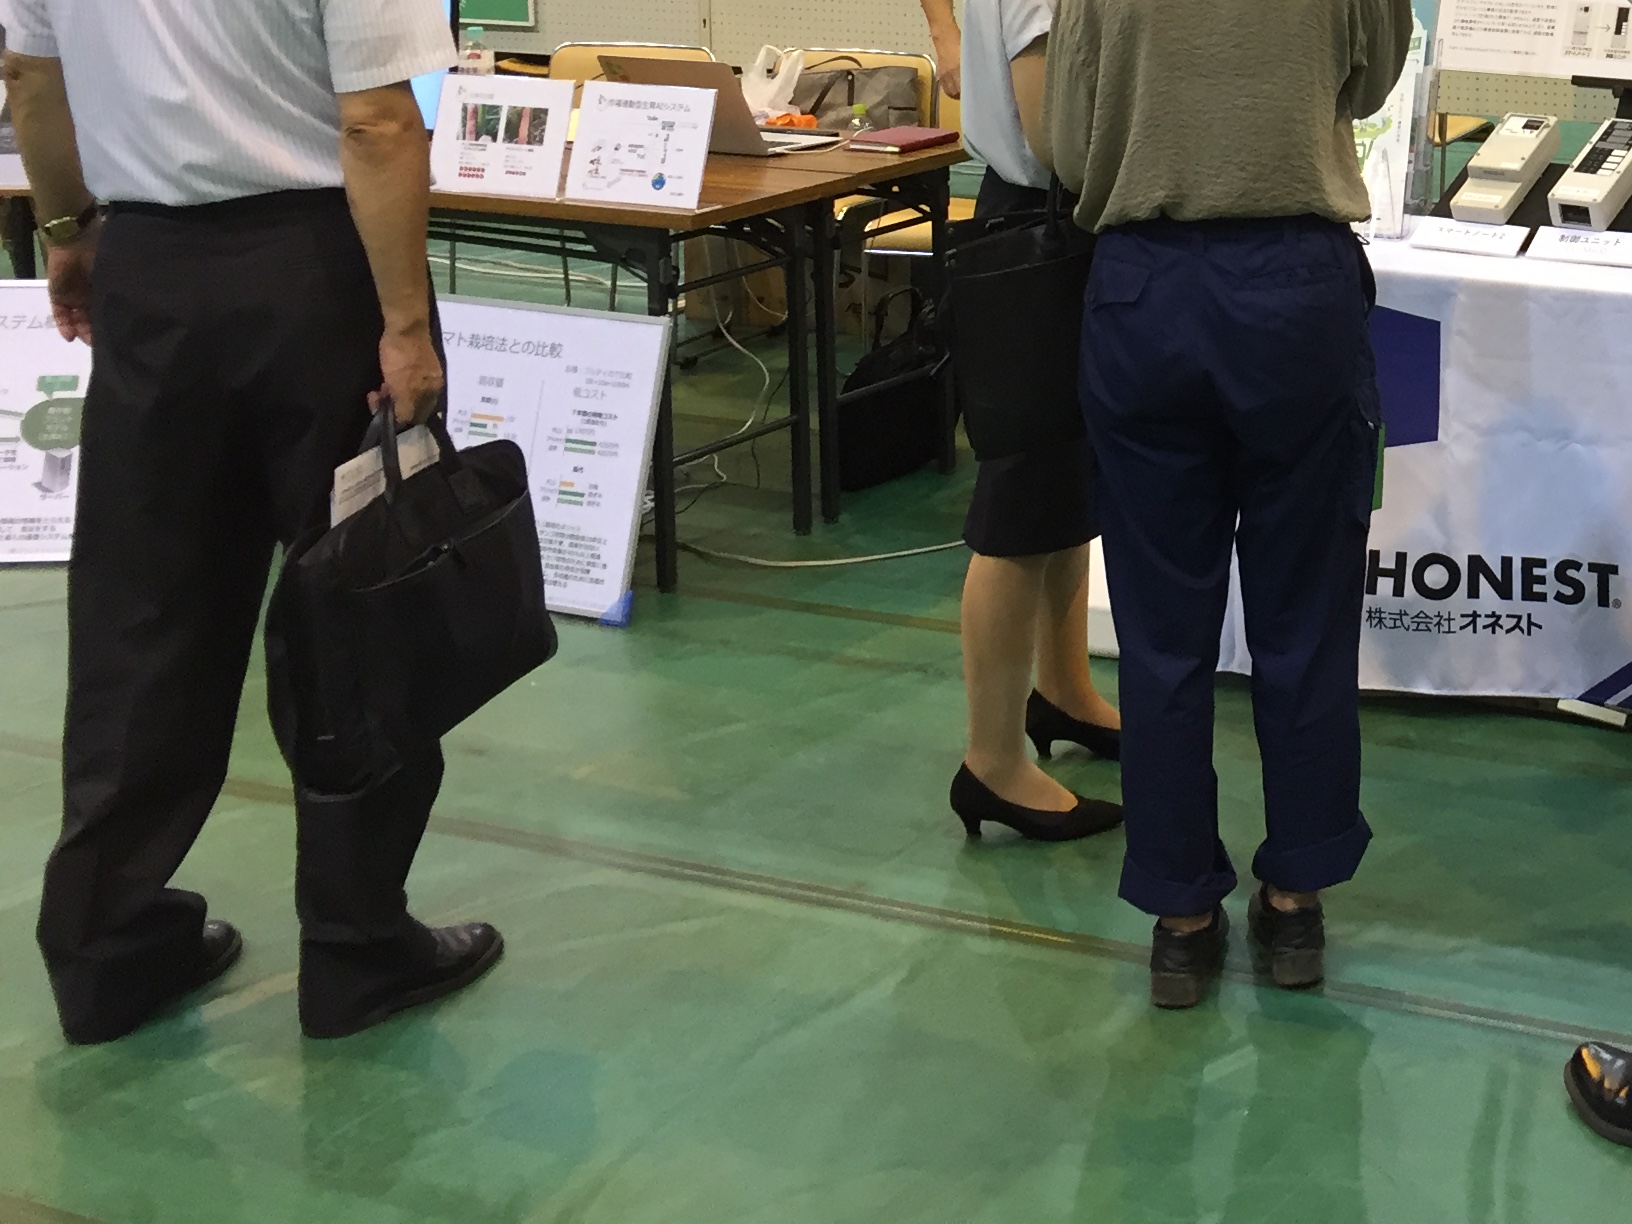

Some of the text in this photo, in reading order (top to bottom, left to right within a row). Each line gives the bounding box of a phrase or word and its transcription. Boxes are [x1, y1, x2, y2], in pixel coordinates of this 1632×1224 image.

[1364, 548, 1620, 608] HONEST
[1365, 607, 1543, 636] 株式会社オネスト
